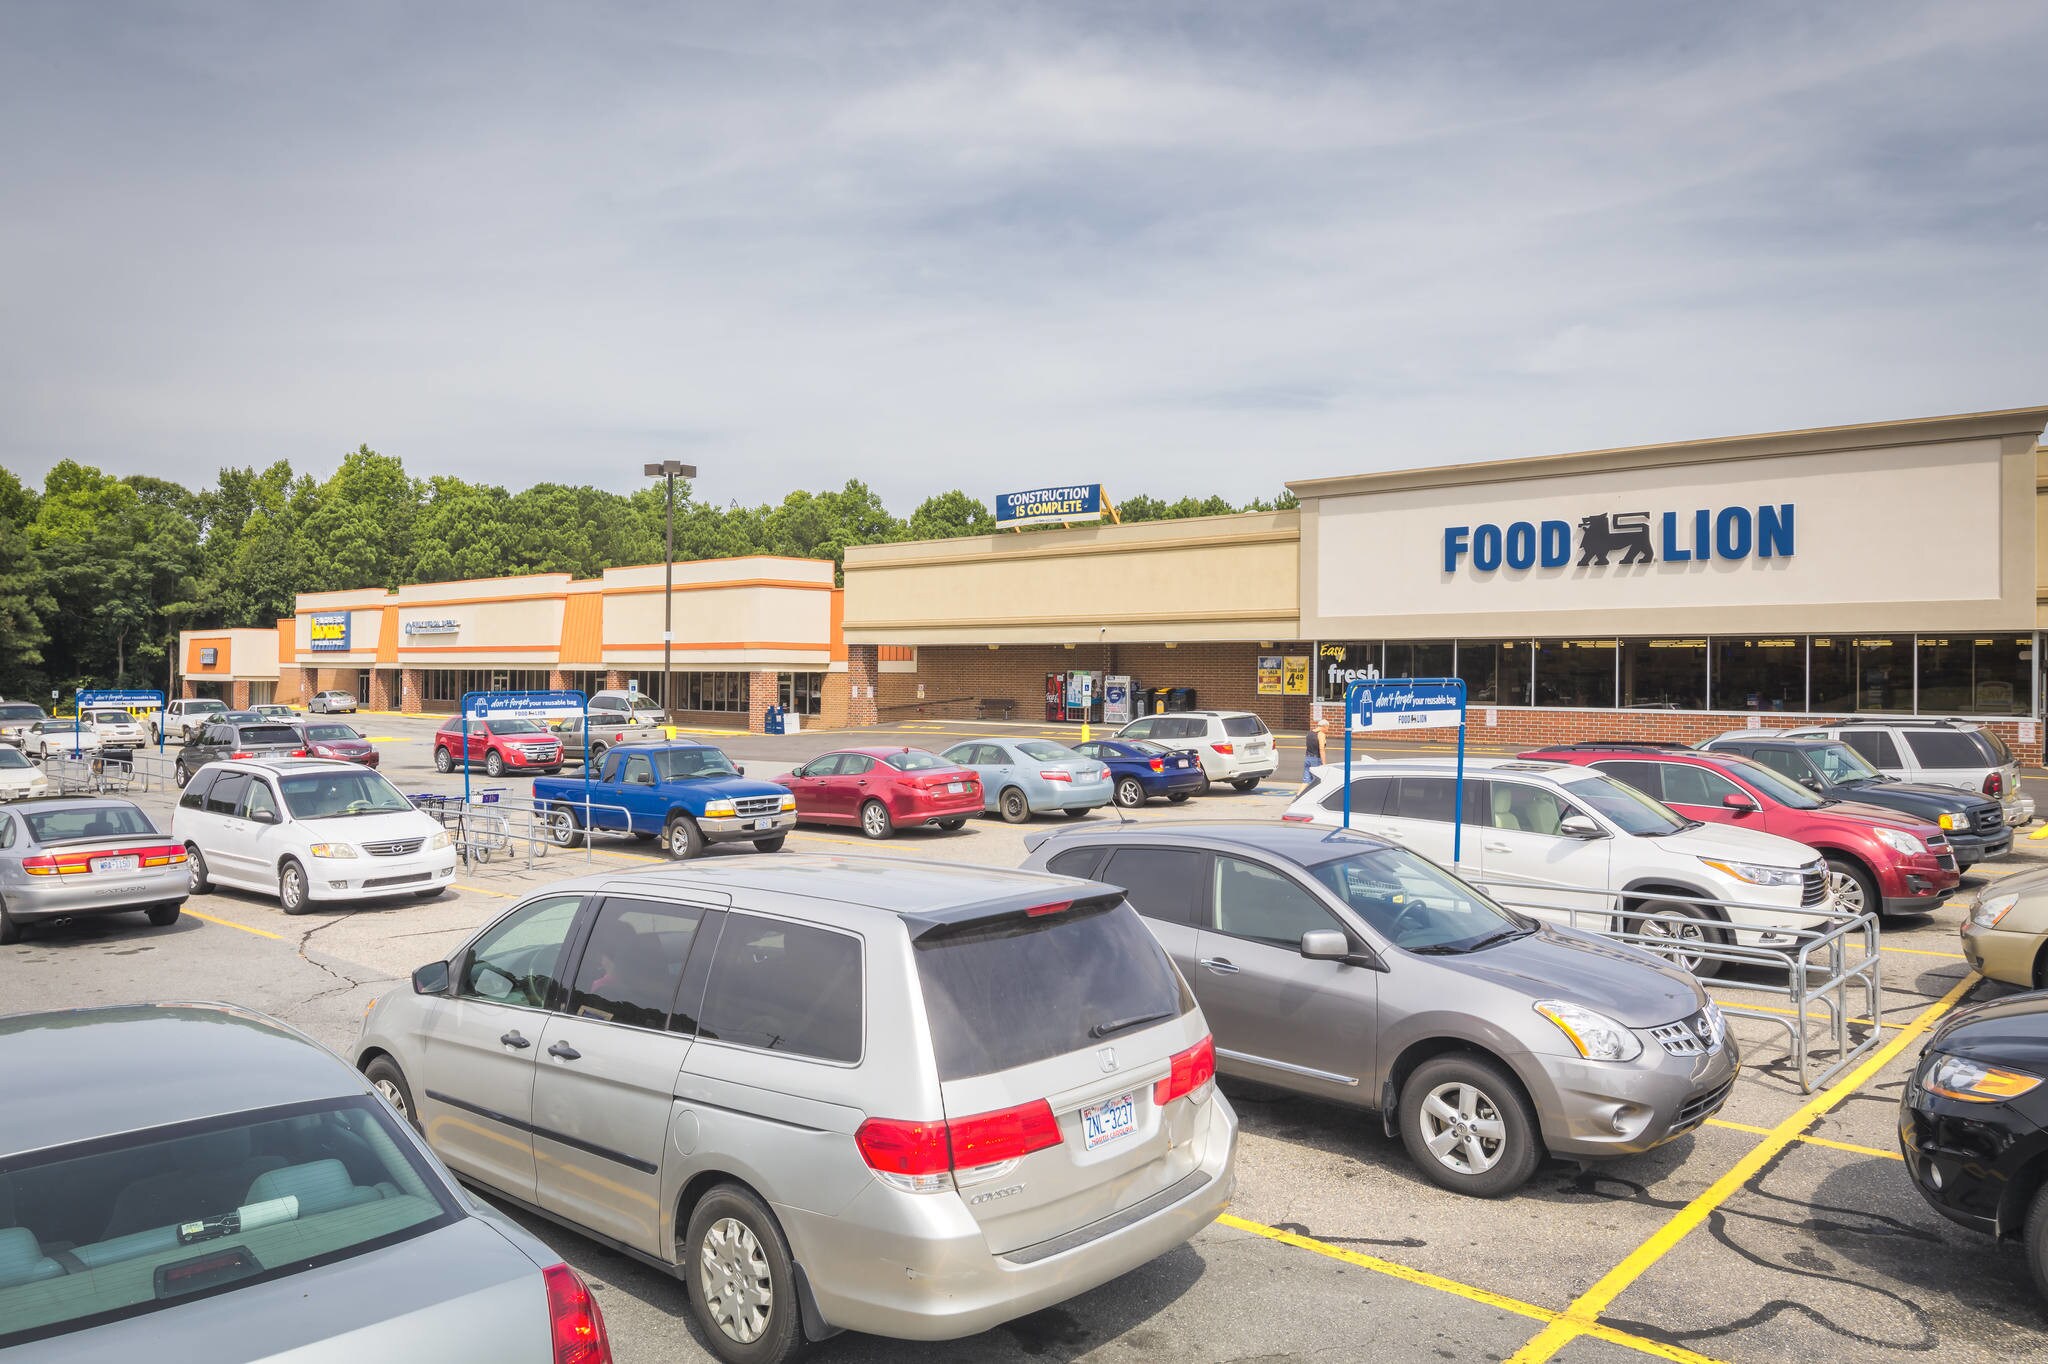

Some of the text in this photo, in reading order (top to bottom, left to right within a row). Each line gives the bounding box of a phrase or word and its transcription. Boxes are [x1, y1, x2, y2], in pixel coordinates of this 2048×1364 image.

[1008, 486, 1090, 506] CONSTRUCTION
[1016, 500, 1082, 517] IS COMPLETE
[1444, 503, 1796, 572] FOOD LION
[1320, 643, 1345, 663] Easy
[1287, 673, 1296, 688] 4
[1328, 663, 1380, 684] fresh
[491, 698, 509, 708] don't
[509, 697, 530, 711] forget
[566, 699, 577, 707] bag
[1376, 691, 1394, 707] don't
[1394, 690, 1414, 711] forget
[1412, 698, 1424, 707] your
[1446, 695, 1456, 705] bag
[95, 885, 146, 895] SATURN
[1086, 1102, 1133, 1138] ZNL-3237
[970, 1183, 1025, 1205] ODYSSEY
